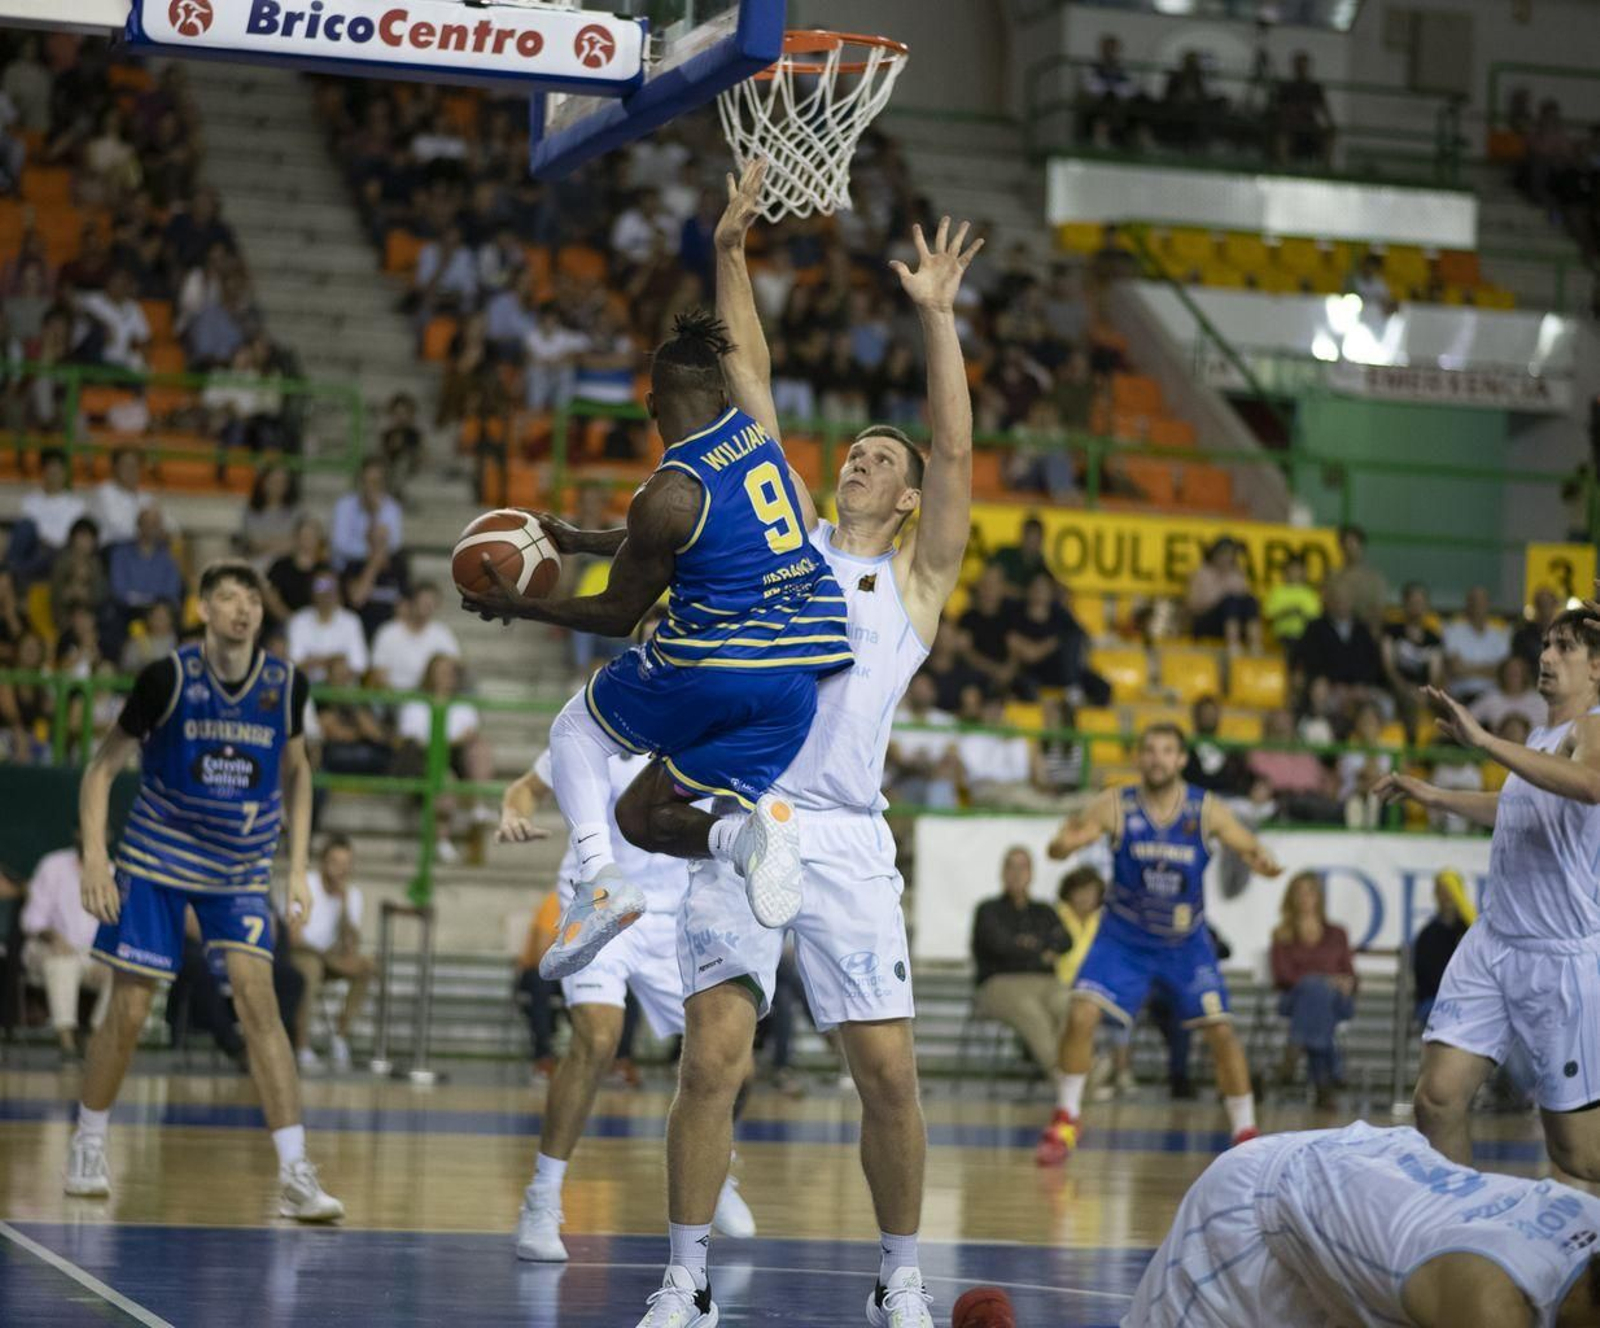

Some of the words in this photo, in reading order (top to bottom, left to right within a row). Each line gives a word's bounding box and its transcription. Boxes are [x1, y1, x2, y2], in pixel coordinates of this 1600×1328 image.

[246, 0, 544, 58] BricoCentro
[744, 460, 803, 556] 9
[241, 801, 260, 835] 7
[242, 915, 265, 945] 7
